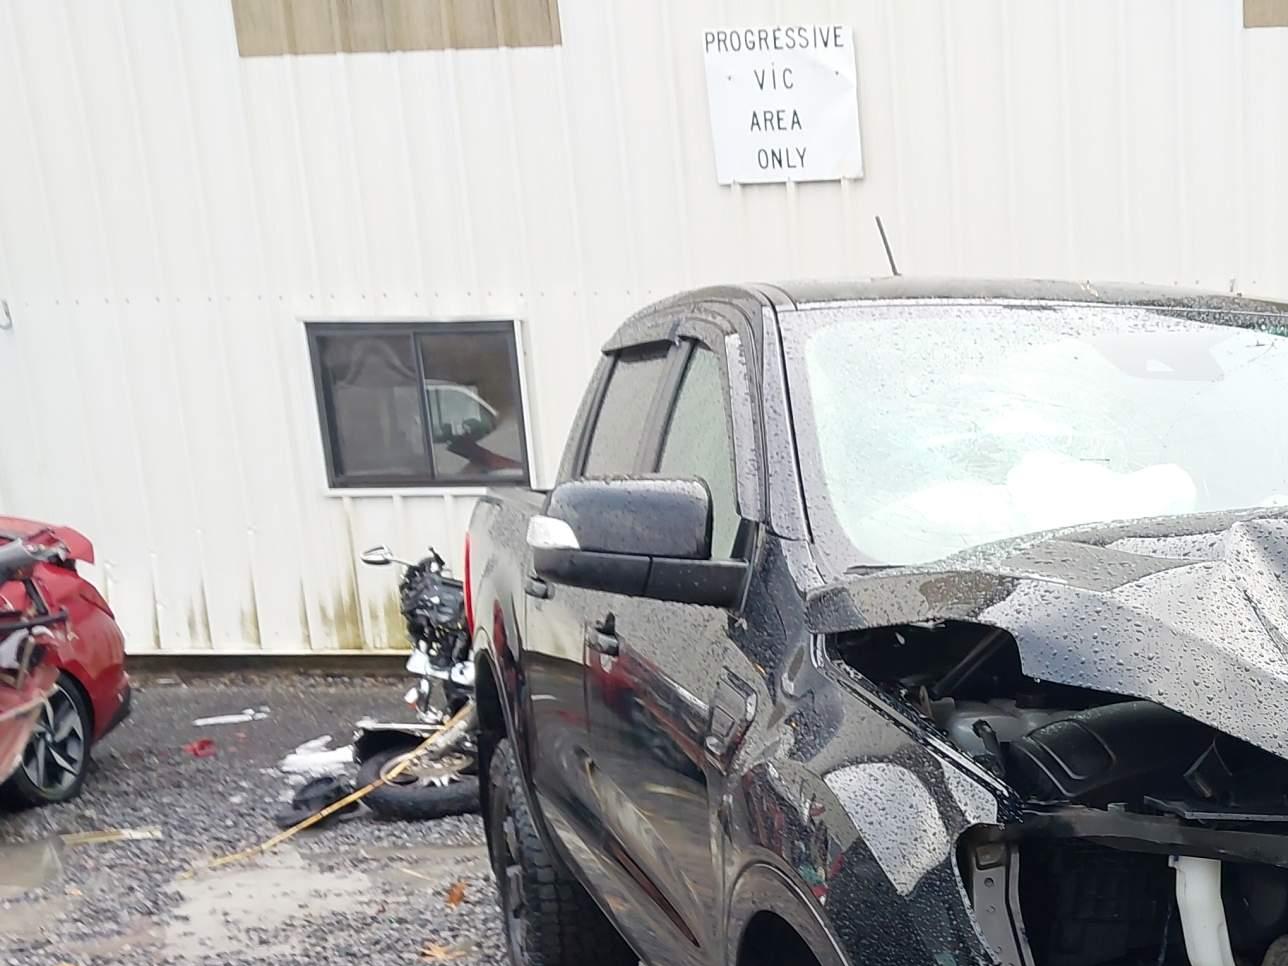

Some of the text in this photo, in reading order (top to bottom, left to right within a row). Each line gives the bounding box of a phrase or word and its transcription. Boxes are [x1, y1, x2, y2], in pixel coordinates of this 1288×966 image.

[704, 25, 844, 53] PROGRESSIVE
[753, 67, 794, 90] VIC
[750, 109, 802, 131] AREA
[757, 147, 807, 169] ONLY
